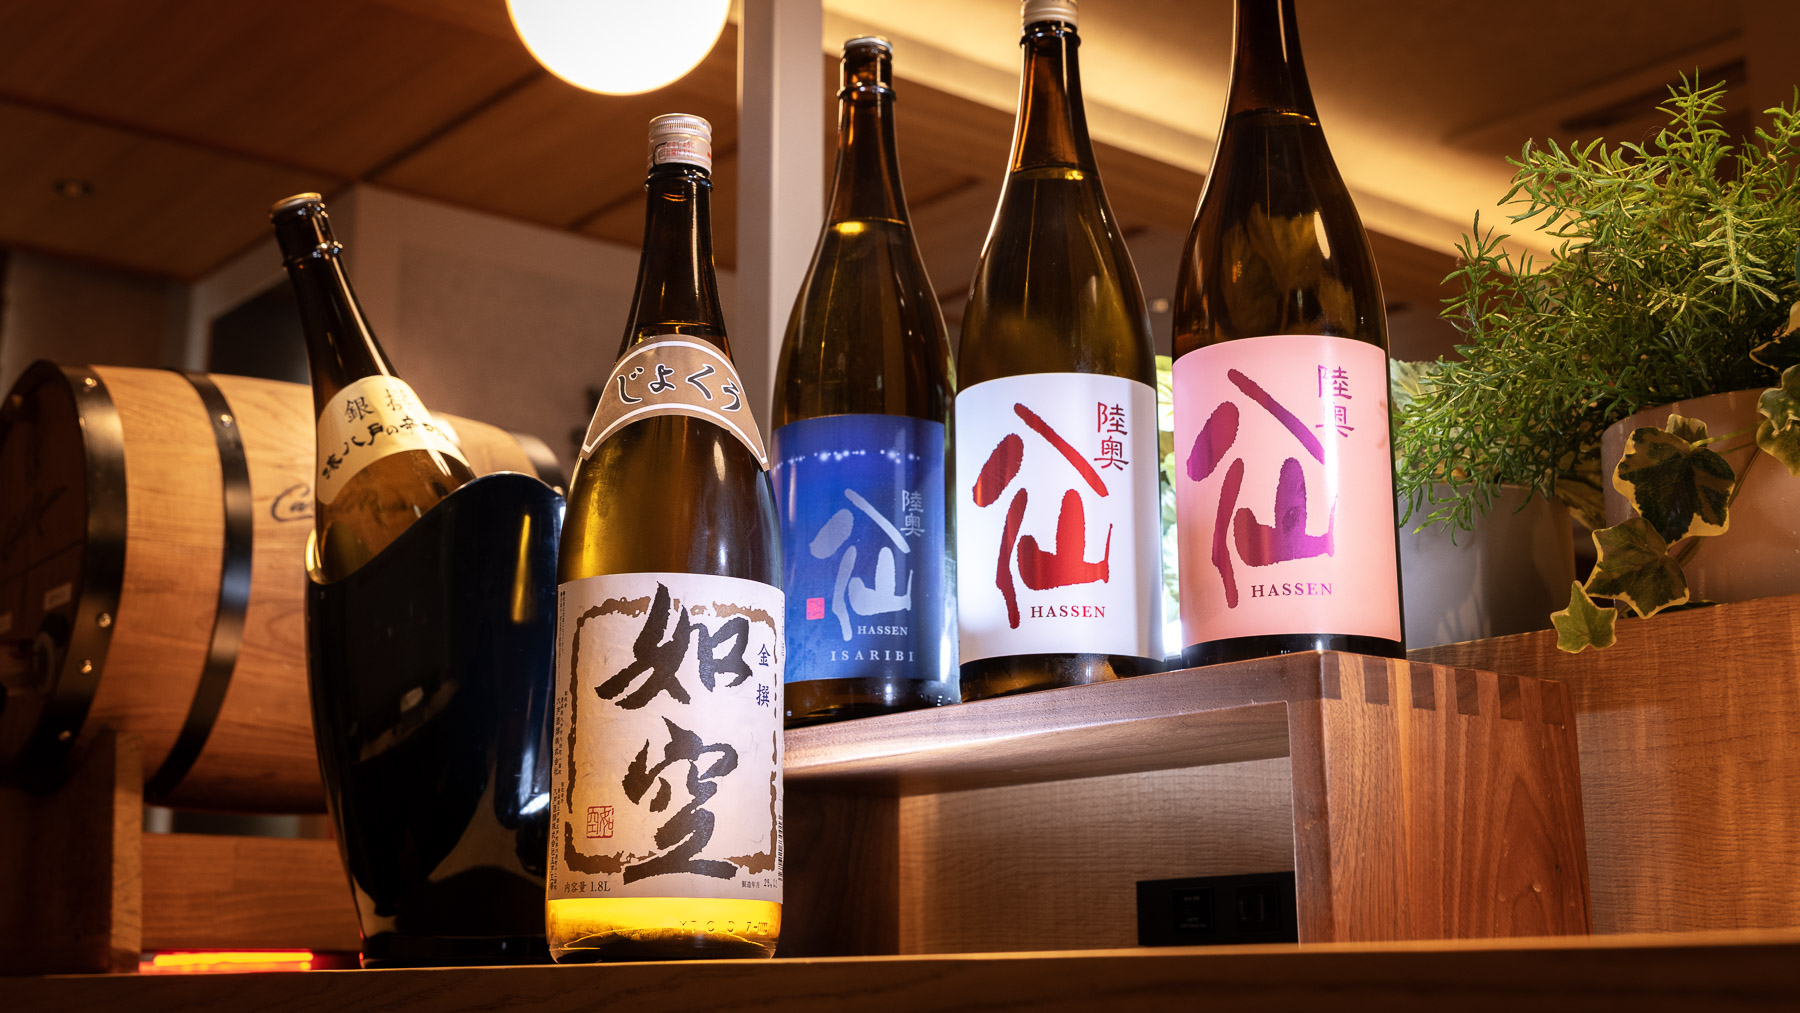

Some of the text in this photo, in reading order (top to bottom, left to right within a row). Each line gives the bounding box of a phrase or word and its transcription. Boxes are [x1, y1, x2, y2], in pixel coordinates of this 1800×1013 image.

[1094, 402, 1129, 471] 陸奥
[900, 489, 925, 537] 陸奥
[972, 403, 1113, 629] 八仙
[809, 488, 914, 641] 八仙
[1250, 582, 1333, 598] HASSEN
[1030, 605, 1106, 618] HASSEN
[857, 625, 908, 636] HASSEN
[831, 650, 914, 662] ISARIBI
[564, 881, 611, 893] 内容量 1.8L
